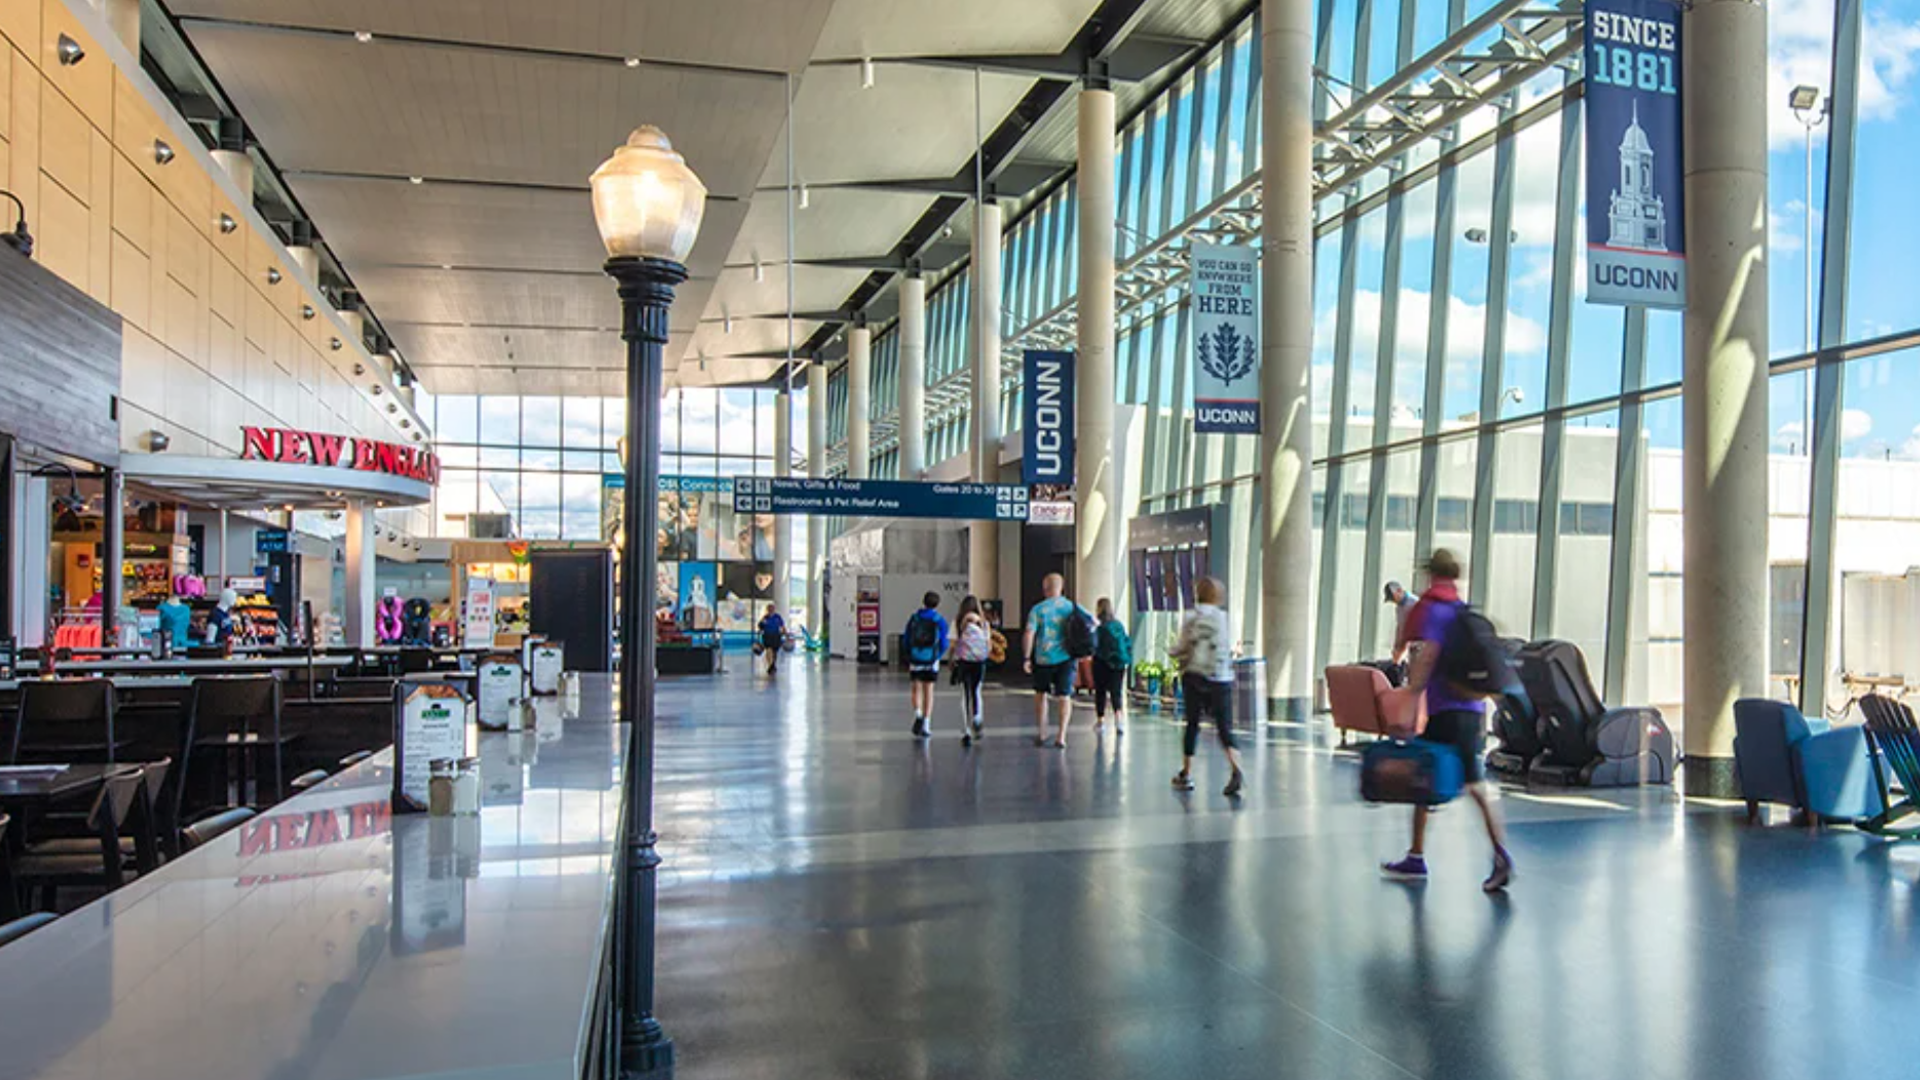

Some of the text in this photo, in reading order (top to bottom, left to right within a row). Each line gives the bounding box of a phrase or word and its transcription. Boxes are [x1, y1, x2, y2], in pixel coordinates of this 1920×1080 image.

[1593, 10, 1676, 50] SINCE
[1593, 44, 1677, 94] 1881
[1198, 259, 1252, 272] YOU CAN GO
[1197, 271, 1252, 284] ANYWHERE
[1595, 263, 1678, 291] UCONN
[1208, 284, 1242, 296] FROM
[1199, 295, 1252, 316] HERE
[1036, 360, 1061, 475] UCONN
[1198, 408, 1256, 424] UCONN
[240, 425, 346, 467] NEW
[773, 479, 996, 495] News, Gifts & Food Gates 20 to 30
[773, 496, 900, 509] Restrooms & Pet Relief Area
